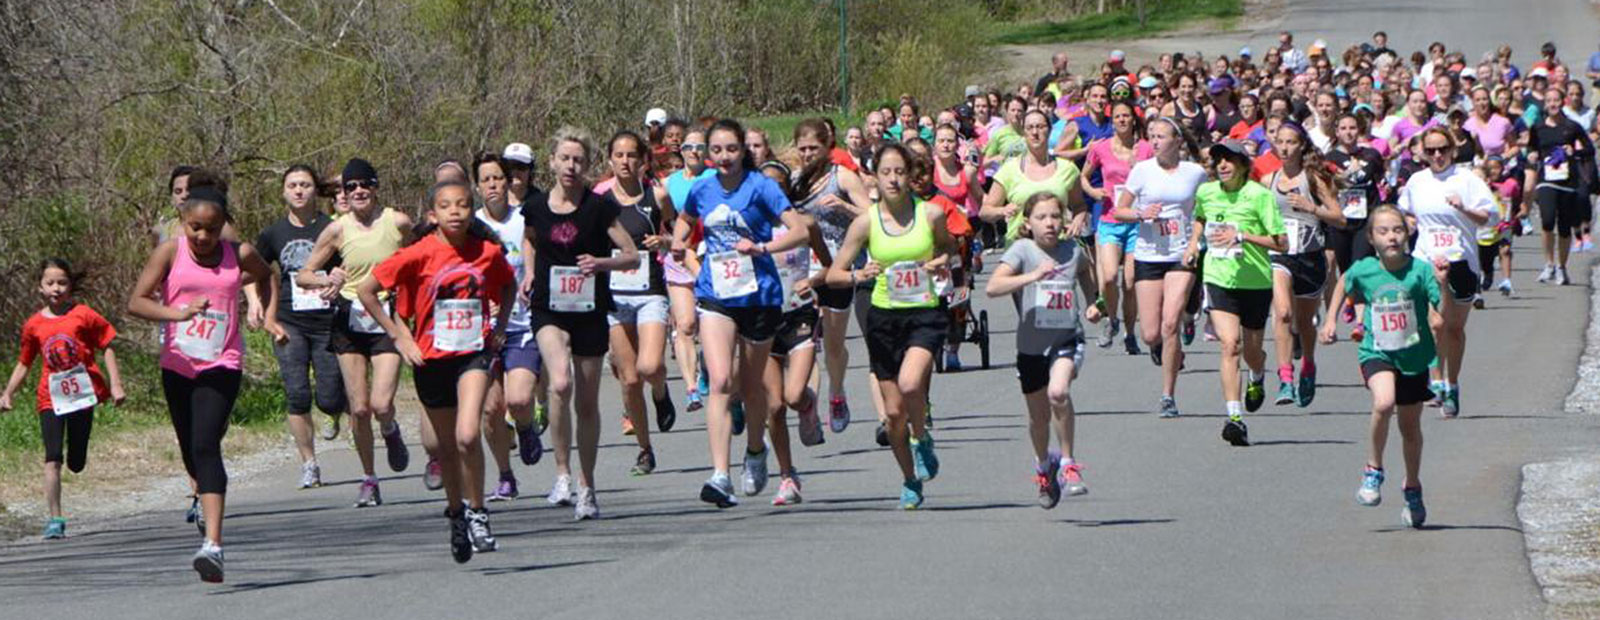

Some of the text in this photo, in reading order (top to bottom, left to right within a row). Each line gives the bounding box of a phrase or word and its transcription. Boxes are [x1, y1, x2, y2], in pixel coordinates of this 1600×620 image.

[1160, 220, 1179, 236] 109
[1434, 233, 1454, 247] 159
[722, 261, 741, 279] 32
[895, 270, 920, 288] 241
[560, 276, 585, 293] 187
[1046, 290, 1073, 310] 218
[185, 317, 217, 340] 247
[446, 310, 473, 330] 123
[1380, 312, 1407, 332] 150
[60, 377, 80, 396] 85
